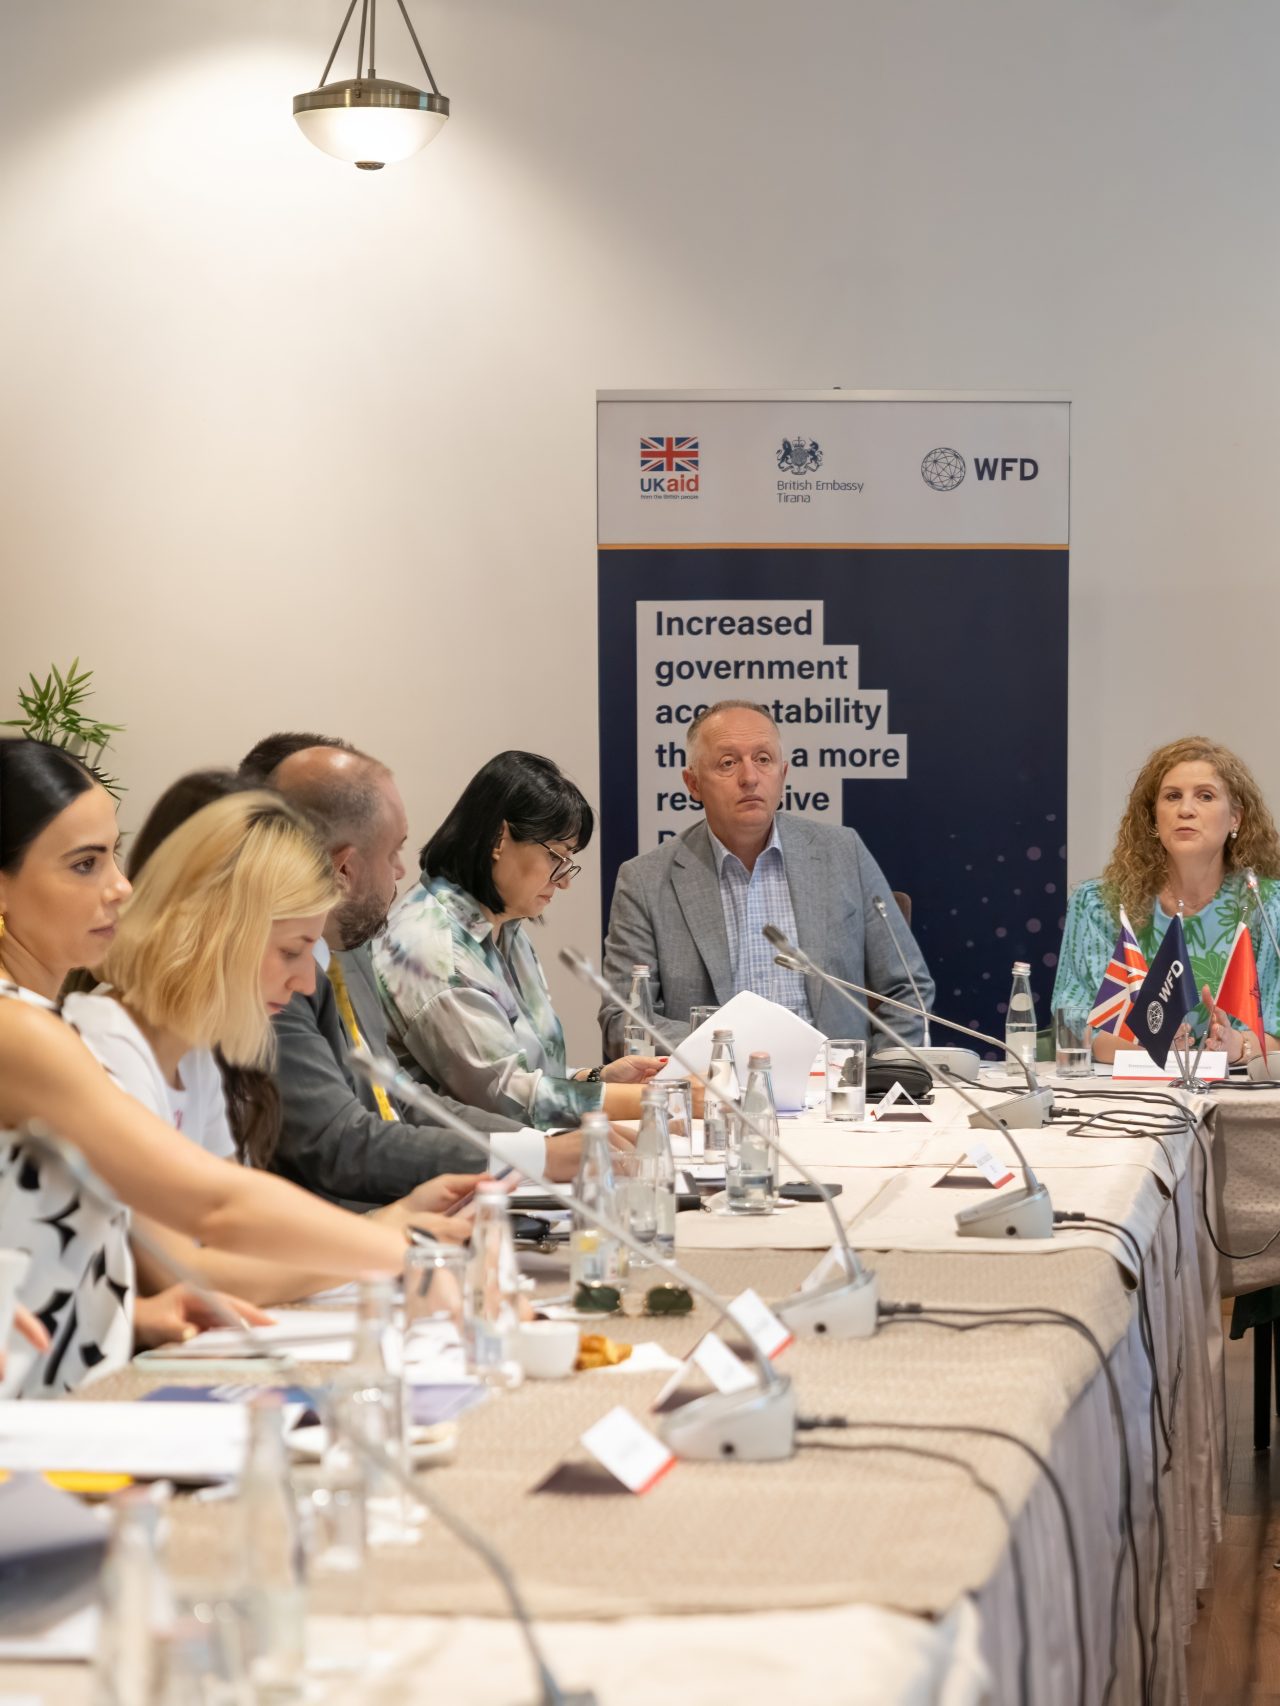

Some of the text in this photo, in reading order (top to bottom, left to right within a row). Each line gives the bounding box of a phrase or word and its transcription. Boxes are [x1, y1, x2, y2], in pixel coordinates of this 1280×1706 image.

[973, 457, 1039, 481] WFD
[777, 480, 864, 493] British Embassy
[777, 492, 811, 503] Tirana
[656, 609, 812, 636] Increased
[655, 656, 848, 687] government
[655, 697, 882, 731] acctability
[791, 747, 900, 768] a more
[657, 785, 830, 811] resive
[1158, 960, 1184, 1003] WFD
